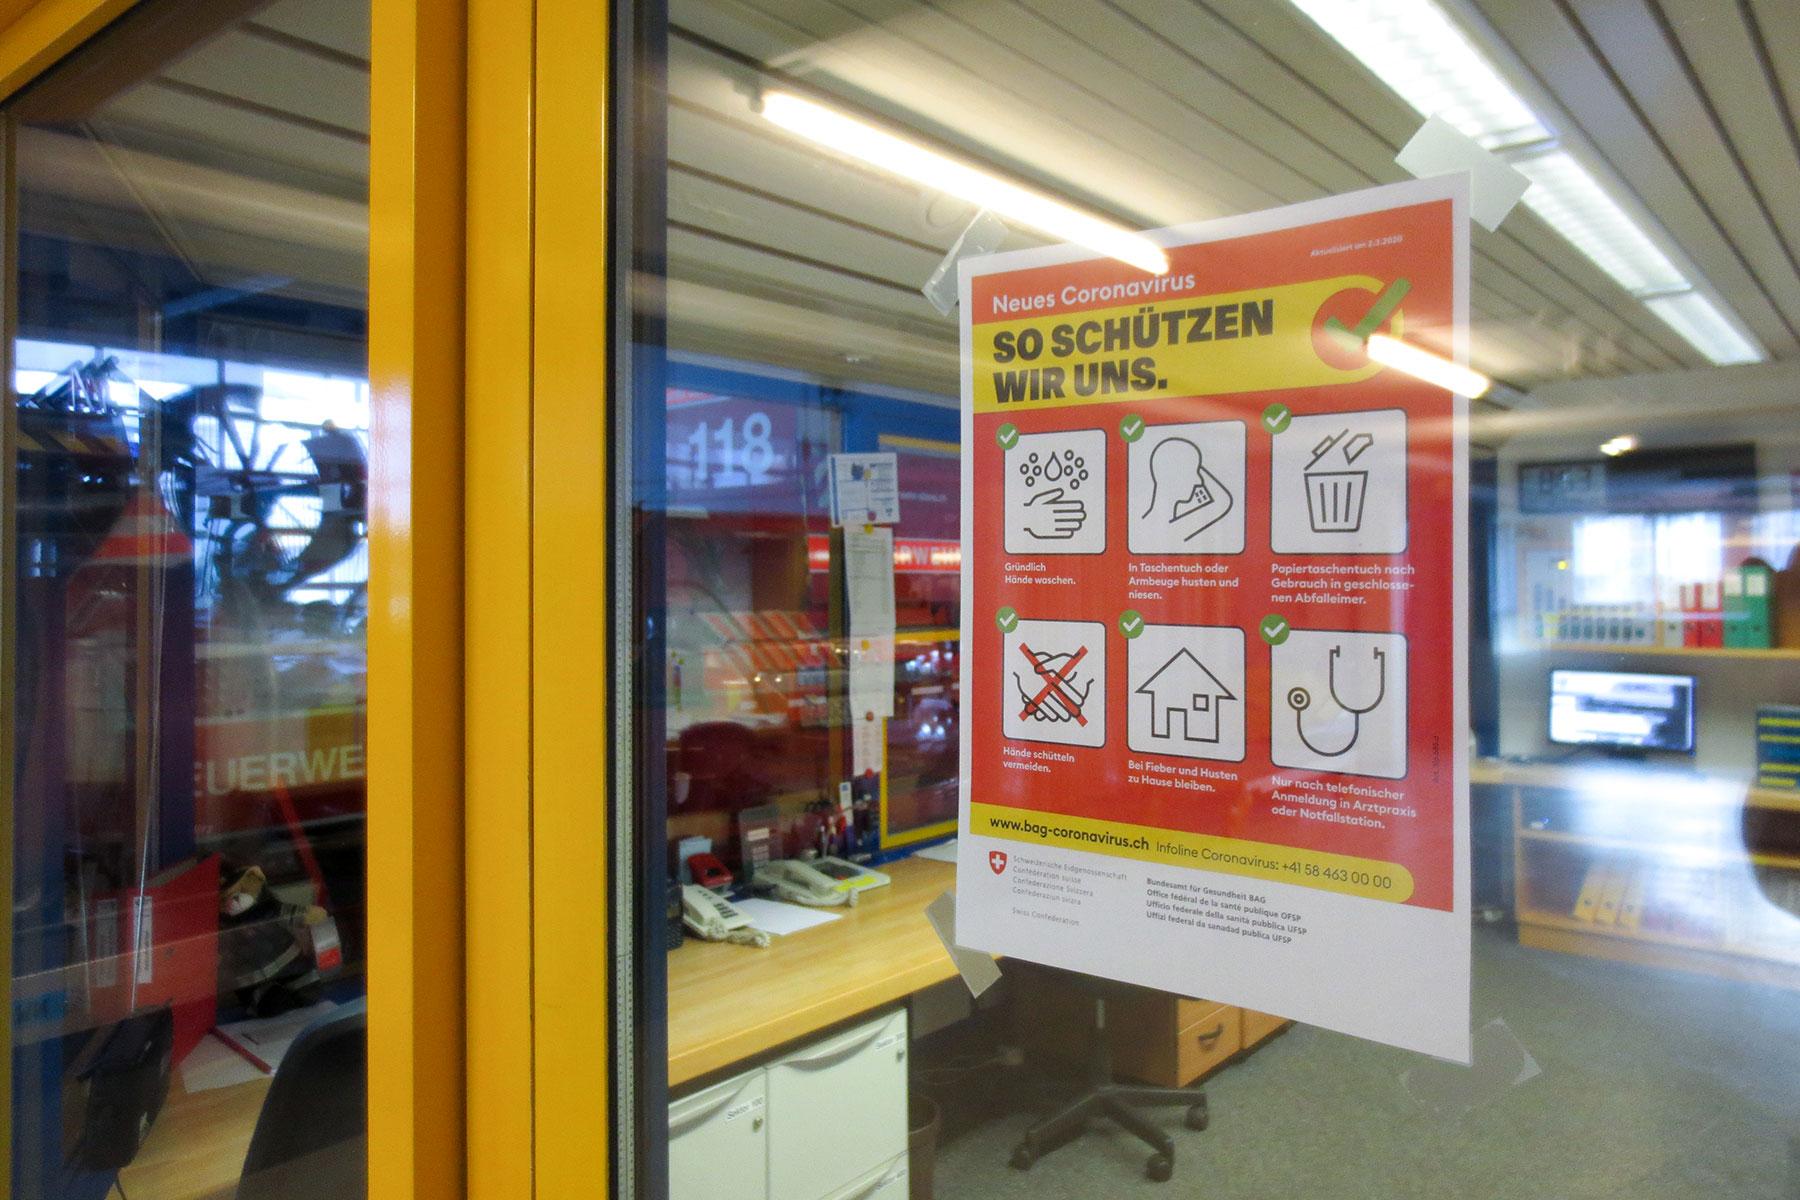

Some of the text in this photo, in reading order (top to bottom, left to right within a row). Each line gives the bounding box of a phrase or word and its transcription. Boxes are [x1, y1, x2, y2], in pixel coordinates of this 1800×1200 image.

[993, 274, 1195, 315] Neues Coronavirus
[993, 300, 1274, 363] SO SCHÜTZEN
[993, 357, 1168, 403] WIR UNS.
[688, 412, 775, 481] 118
[1005, 562, 1046, 573] Gründlich
[1129, 563, 1229, 574] In Taschentuch oder
[1271, 563, 1415, 576] Papiertaschentuch nach
[1005, 575, 1076, 585] Hände waschen.
[1128, 577, 1239, 589] Armbeuge husten und
[1271, 578, 1414, 592] Gebrauch in geschlosse-
[1128, 590, 1163, 600] niesen.
[1271, 593, 1367, 605] nen Abfalleimer.
[1003, 747, 1075, 763] Hände schütteln
[1003, 761, 1052, 773] vermeiden.
[1128, 760, 1238, 781] Bei Fieber und Husten
[1128, 775, 1216, 793] zu Hause bleiben.
[1272, 776, 1404, 800] Nur nach telefonischer
[1271, 790, 1417, 818] Anmeldung in Arztpraxis
[1272, 806, 1386, 829] oder Notfallstation.
[990, 817, 1392, 889] www.bag-coronavirus.ch Infoline Coronavirus: +41 58 463 00 00
[1147, 878, 1188, 891] Bundesamt
[1203, 888, 1247, 901] Gesundheit
[1249, 894, 1266, 904] BAG
[1147, 889, 1169, 899] Office
[1199, 897, 1209, 906] de
[1211, 899, 1219, 907] la
[1244, 905, 1278, 919] publique
[1281, 911, 1302, 922] OFSP
[1147, 900, 1171, 911] Ufficio
[1172, 904, 1204, 917] federale
[1205, 909, 1224, 920] della
[1252, 918, 1285, 931] pubblica
[1287, 926, 1308, 936] UFSP
[1168, 915, 1194, 927] federal
[1196, 920, 1206, 928] da
[1242, 928, 1270, 941] publica
